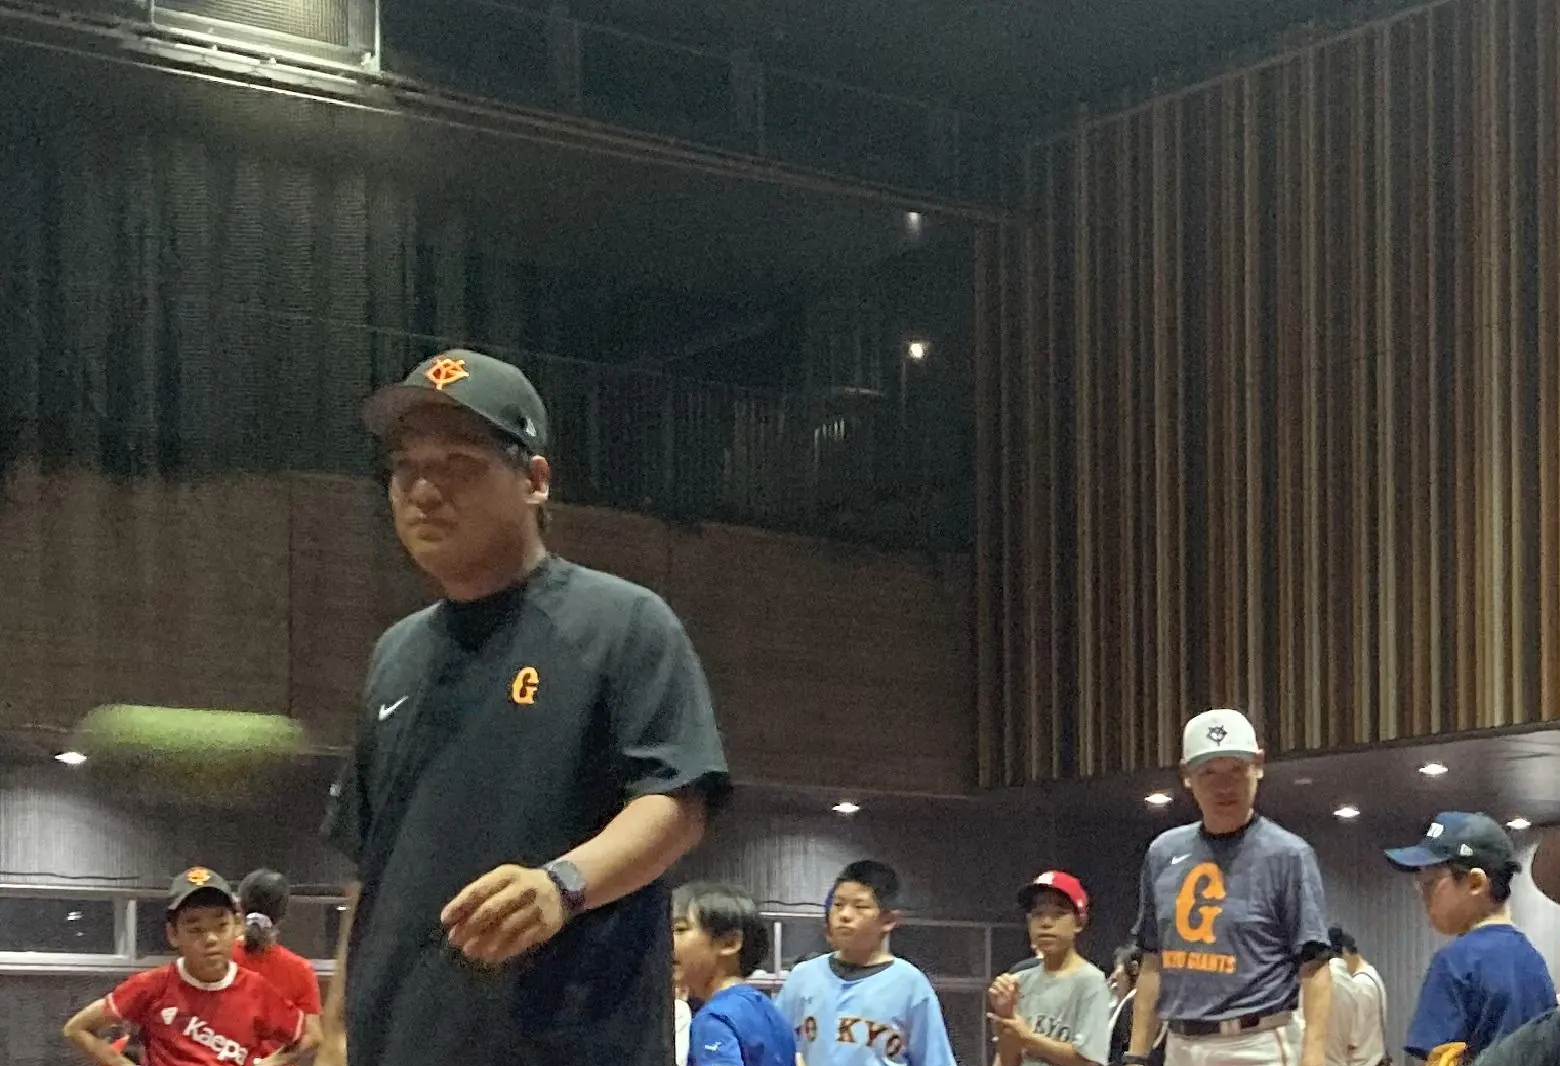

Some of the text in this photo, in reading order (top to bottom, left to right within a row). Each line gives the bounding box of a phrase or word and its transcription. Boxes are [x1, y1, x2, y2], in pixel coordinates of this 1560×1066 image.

[513, 666, 539, 704] G
[1175, 861, 1226, 943] G
[182, 1016, 248, 1066] Kaepa
